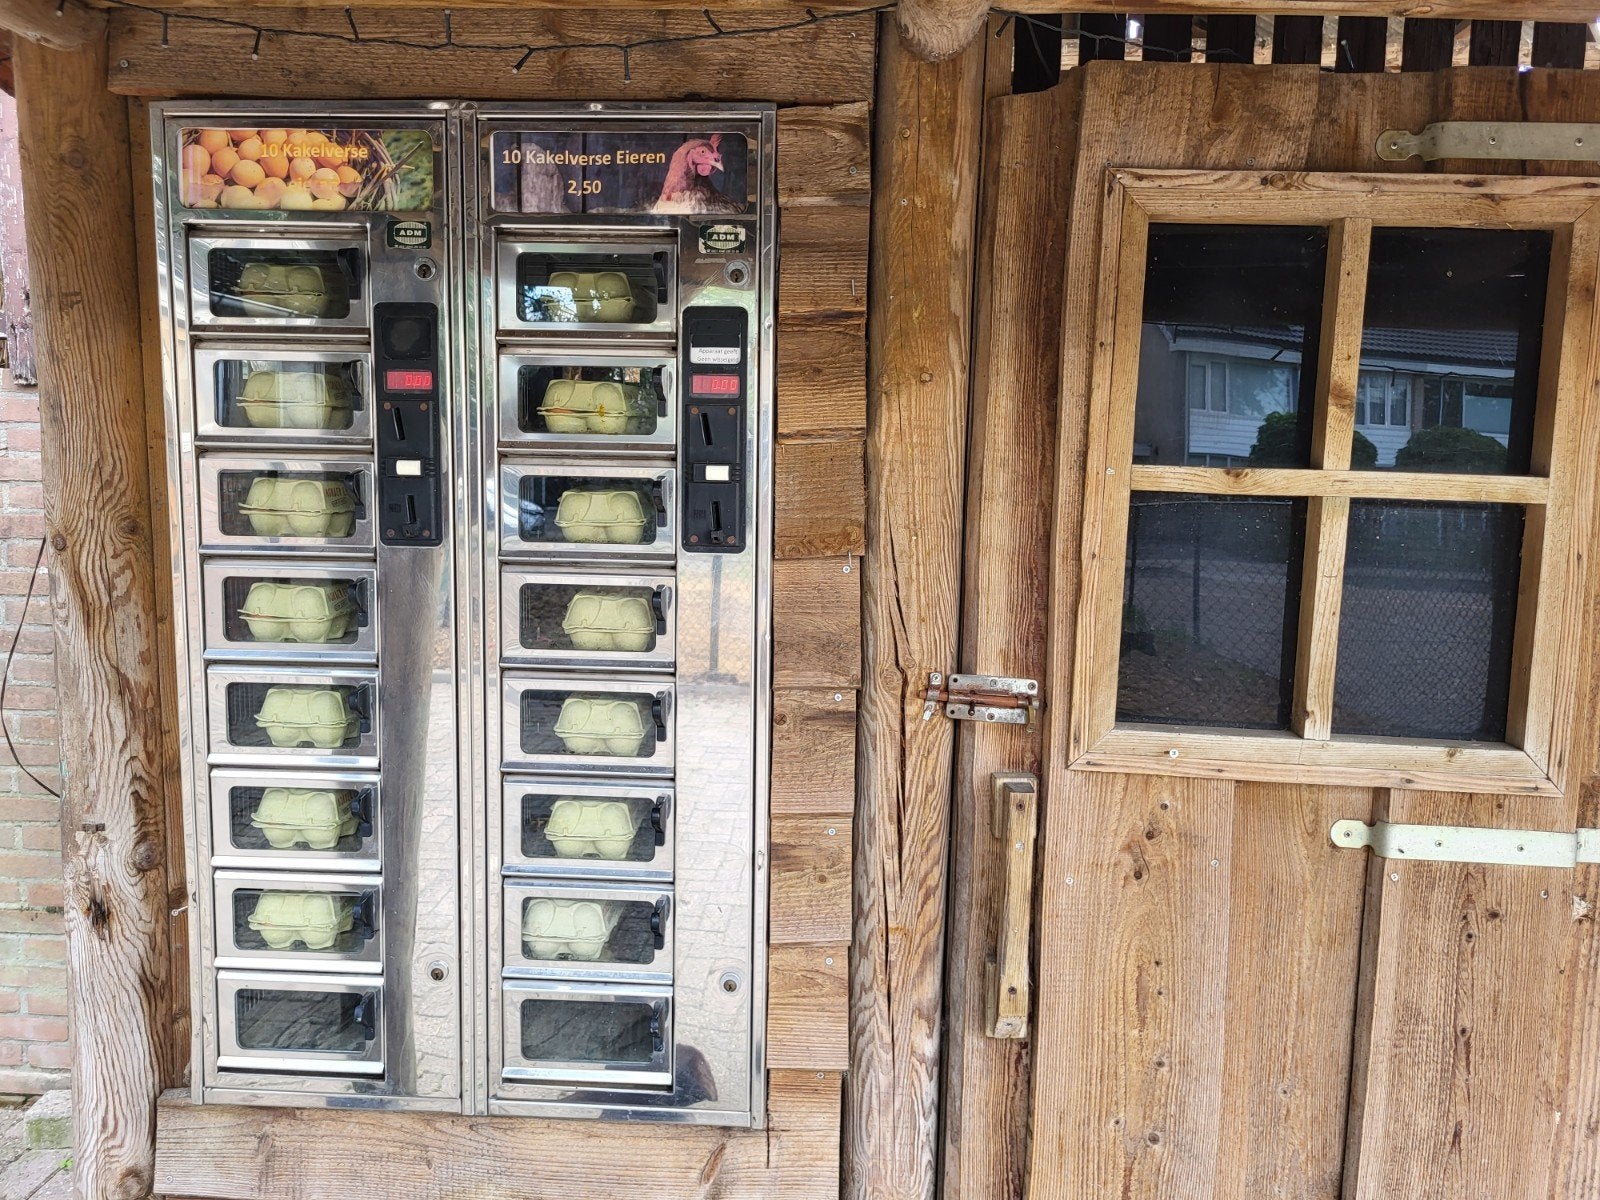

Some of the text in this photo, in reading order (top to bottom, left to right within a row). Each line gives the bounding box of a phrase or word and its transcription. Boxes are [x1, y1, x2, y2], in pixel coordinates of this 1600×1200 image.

[260, 143, 369, 159] 10 Kakelverse
[502, 150, 666, 166] 10 Kakelverse Eieren
[567, 179, 602, 197] 2,50
[399, 229, 422, 237] ADM
[711, 233, 735, 241] ADM
